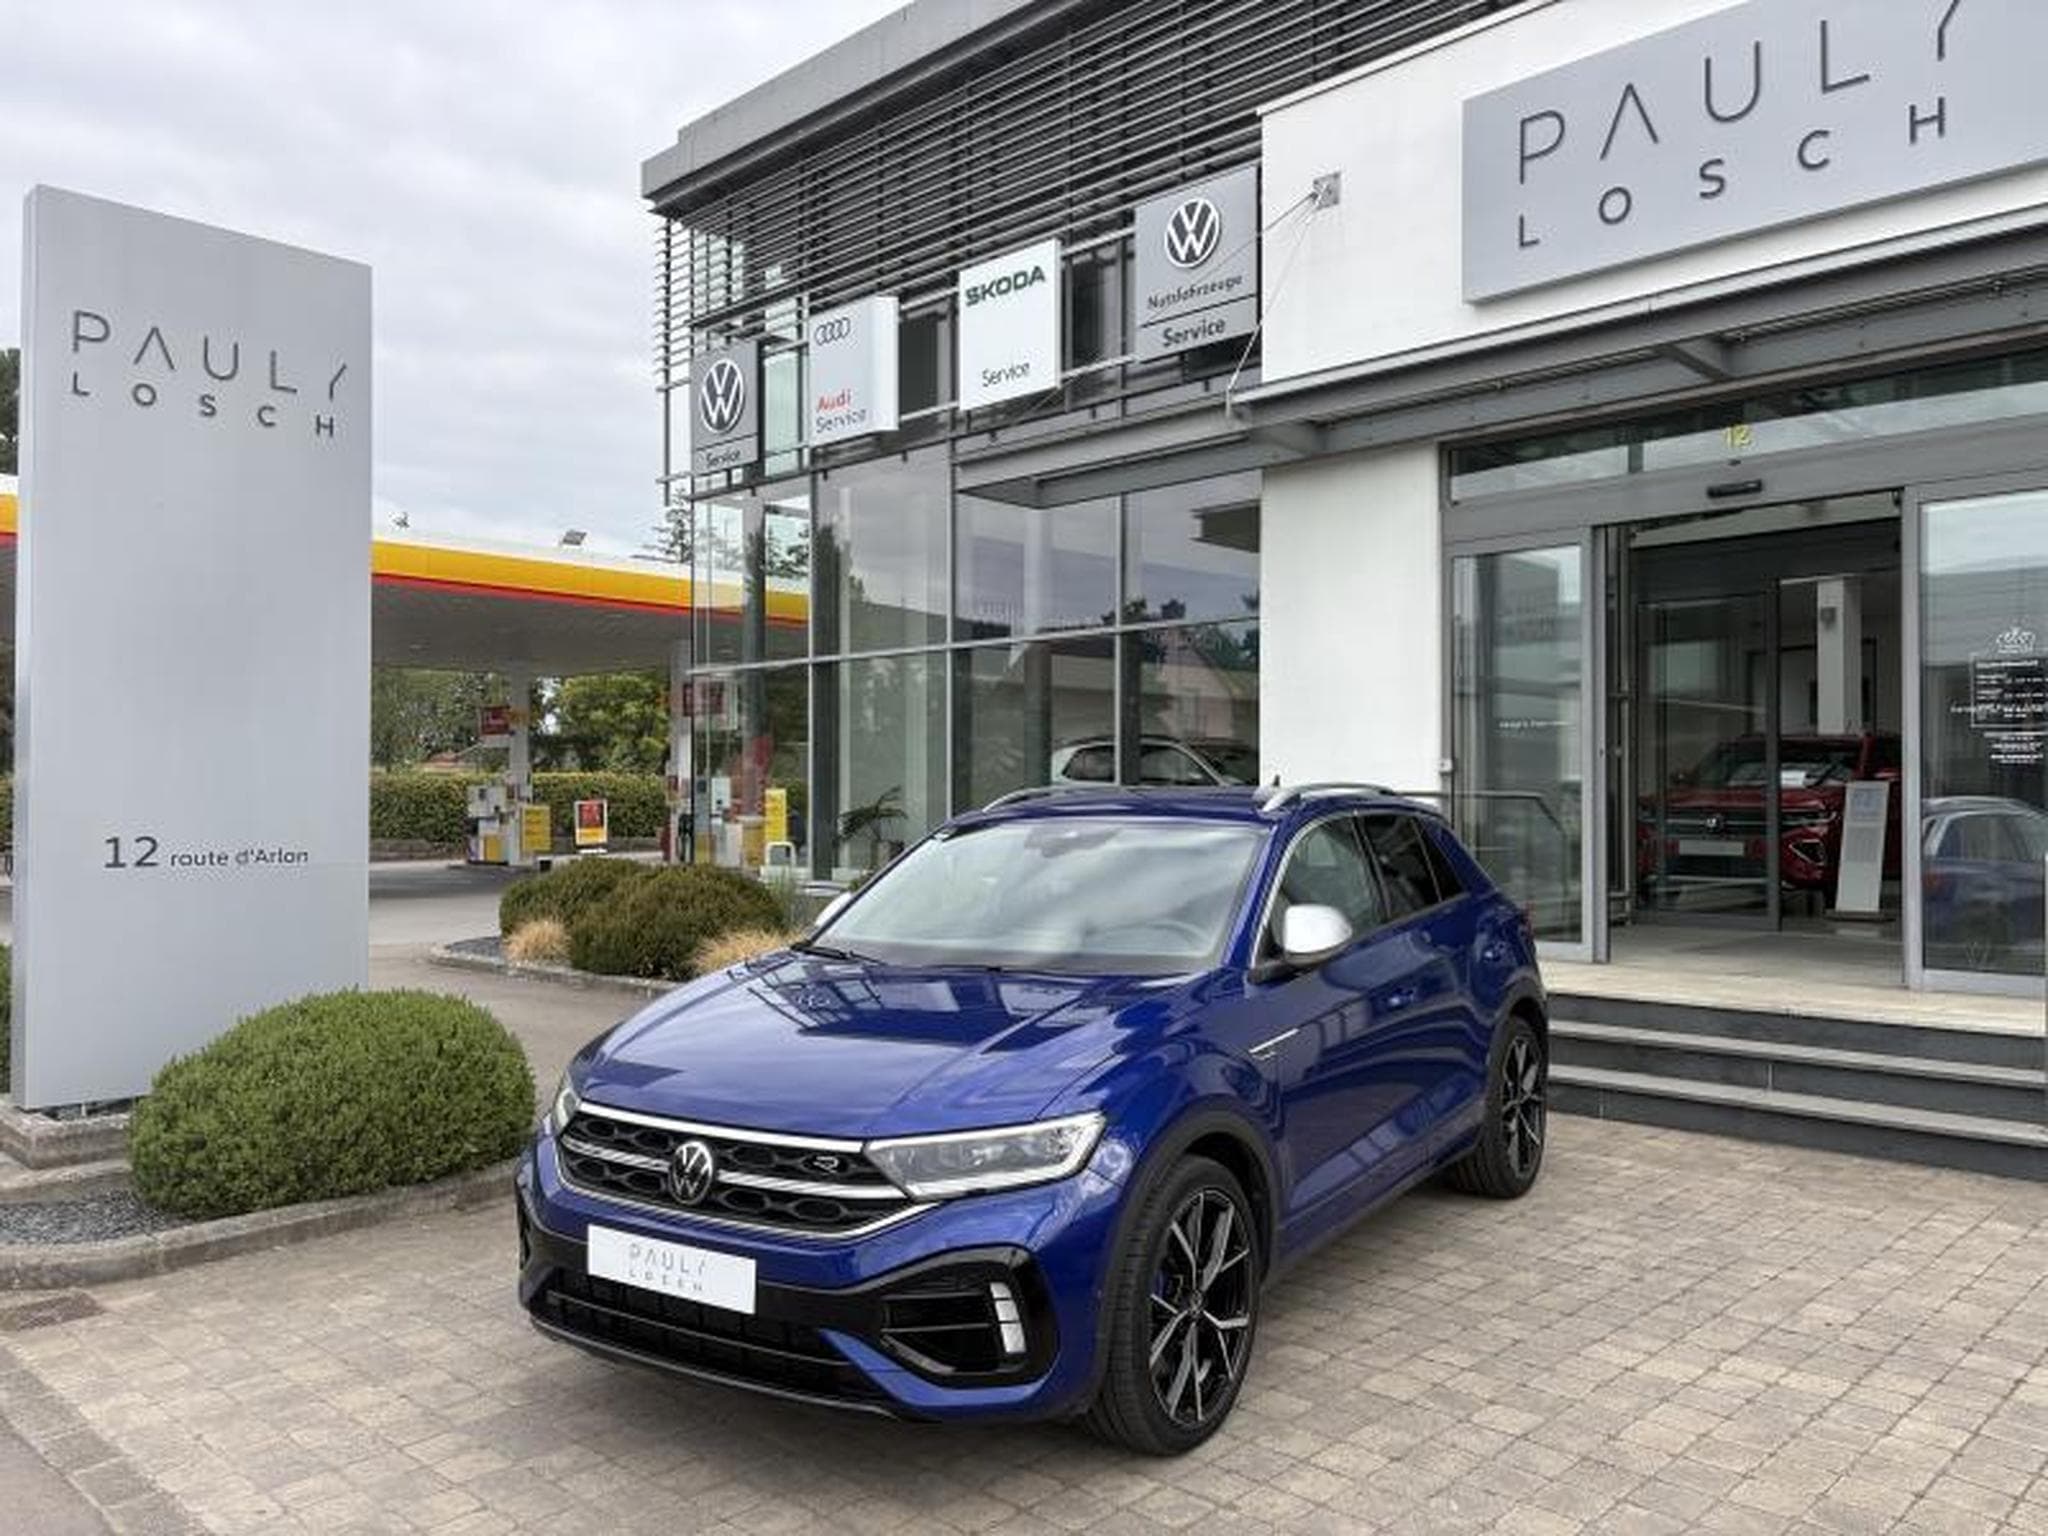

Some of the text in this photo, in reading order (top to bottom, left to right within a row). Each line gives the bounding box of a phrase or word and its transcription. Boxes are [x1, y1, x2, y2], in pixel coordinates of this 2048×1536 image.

[1517, 95, 1946, 249] LOSCH
[1162, 318, 1226, 348] Service
[72, 308, 348, 402] PAULY
[981, 361, 1030, 389] Service
[71, 369, 336, 438] LOSCH
[817, 388, 852, 412] Audi
[816, 409, 867, 435] Service
[705, 450, 741, 468] Service
[103, 835, 309, 868] 12 route d'Arlon
